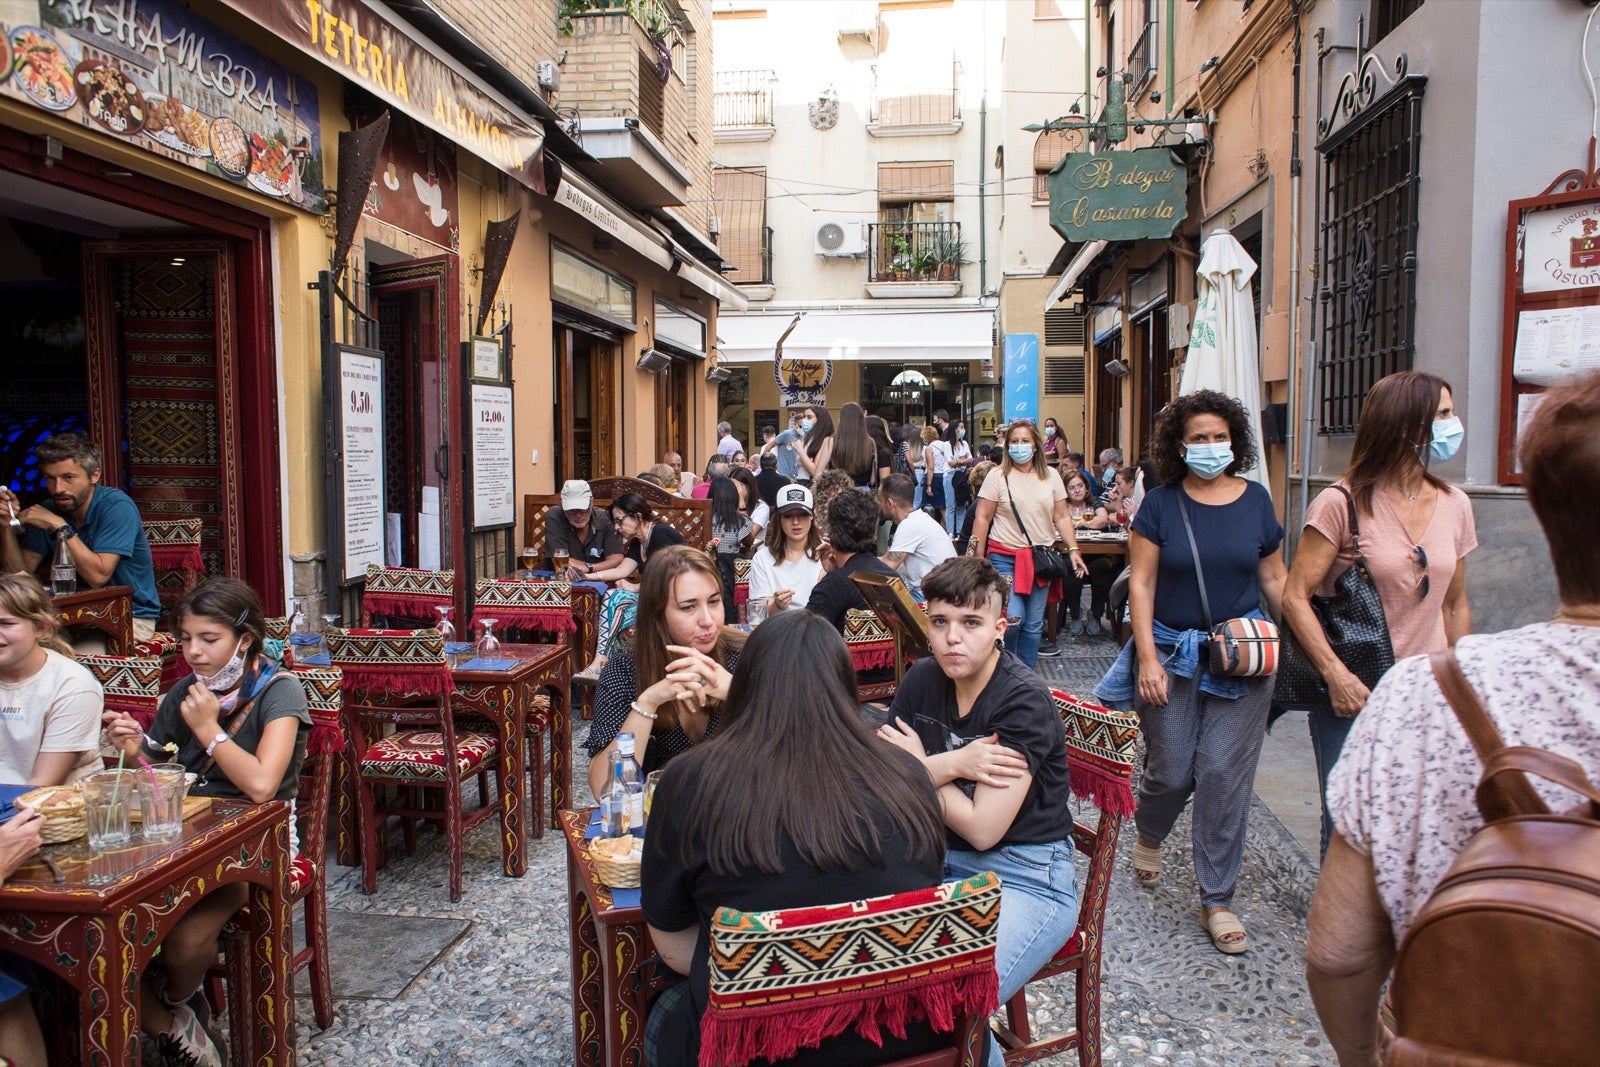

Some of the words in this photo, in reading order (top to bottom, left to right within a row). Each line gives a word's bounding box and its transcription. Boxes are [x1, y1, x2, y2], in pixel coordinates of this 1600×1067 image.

[306, 0, 409, 103] TETERÍA
[434, 88, 524, 172] ALHAMBRA
[214, 155, 246, 175] PASTELA
[1072, 157, 1177, 193] Bodegas
[1058, 196, 1176, 229] Castañeda
[1551, 209, 1589, 237] Antigua
[1008, 341, 1036, 412] Nora
